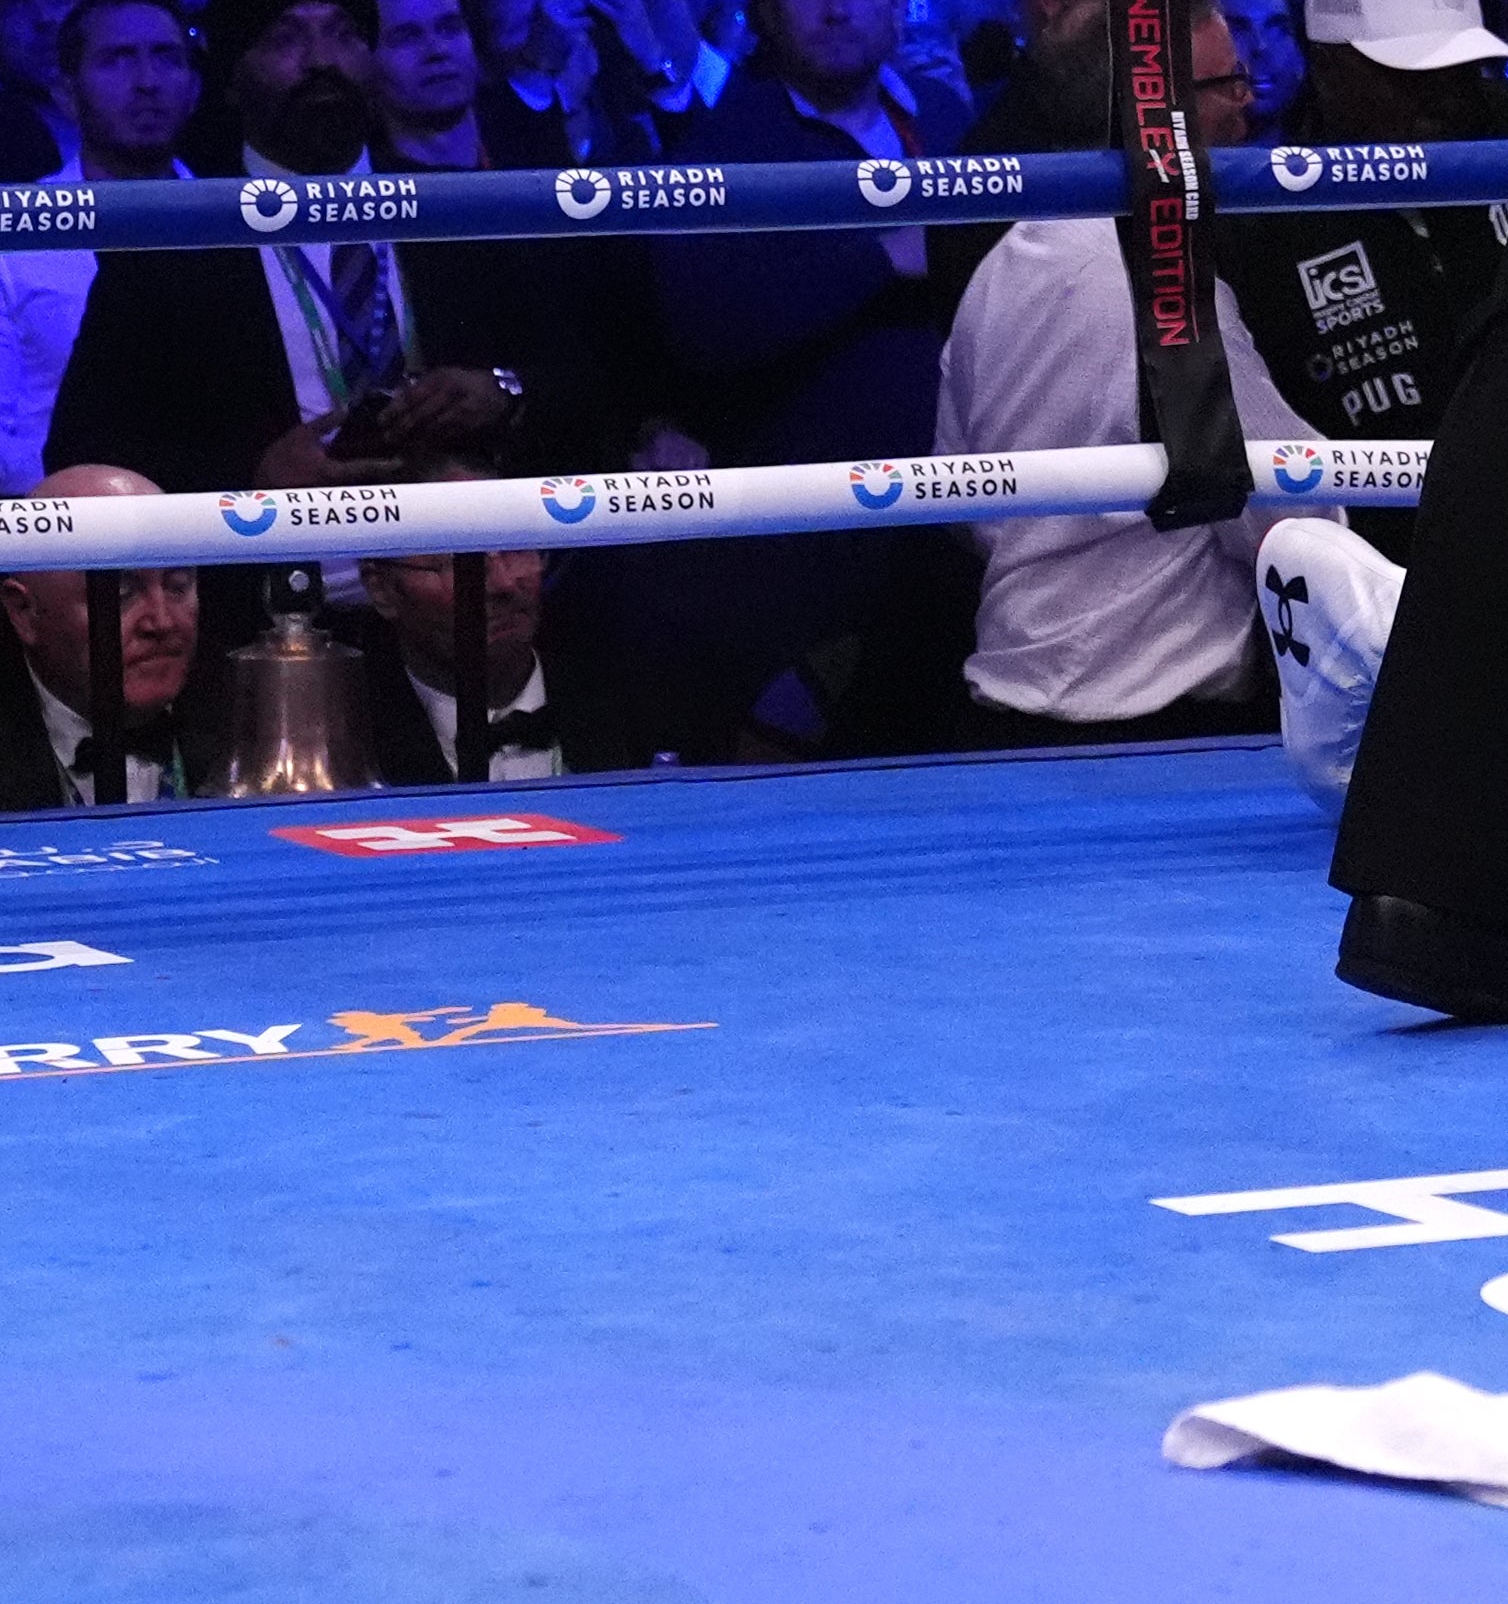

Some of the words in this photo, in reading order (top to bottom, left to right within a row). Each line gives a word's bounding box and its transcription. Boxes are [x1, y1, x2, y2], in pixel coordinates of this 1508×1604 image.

[1325, 144, 1425, 161] RIYADH
[617, 167, 724, 186] RIYADH
[916, 156, 1021, 175] RIYADH
[1331, 161, 1427, 183] SEASON
[305, 178, 417, 199] RIYADH
[921, 174, 1023, 198] SEASON
[621, 186, 726, 209] SEASON
[308, 199, 418, 223] SEASON
[1149, 198, 1190, 347] EDITION
[1316, 302, 1385, 335] SPORTS
[1332, 320, 1414, 360] RIYADH
[1336, 335, 1419, 375] SEASON
[1341, 372, 1422, 427] PUG
[910, 459, 1015, 477] RIYADH
[1332, 450, 1429, 467] RIYADH
[603, 474, 711, 491] RIYADH
[915, 477, 1017, 500] SEASON
[285, 488, 397, 504] RIYADH
[608, 491, 714, 514] SEASON
[290, 504, 401, 526] SEASON
